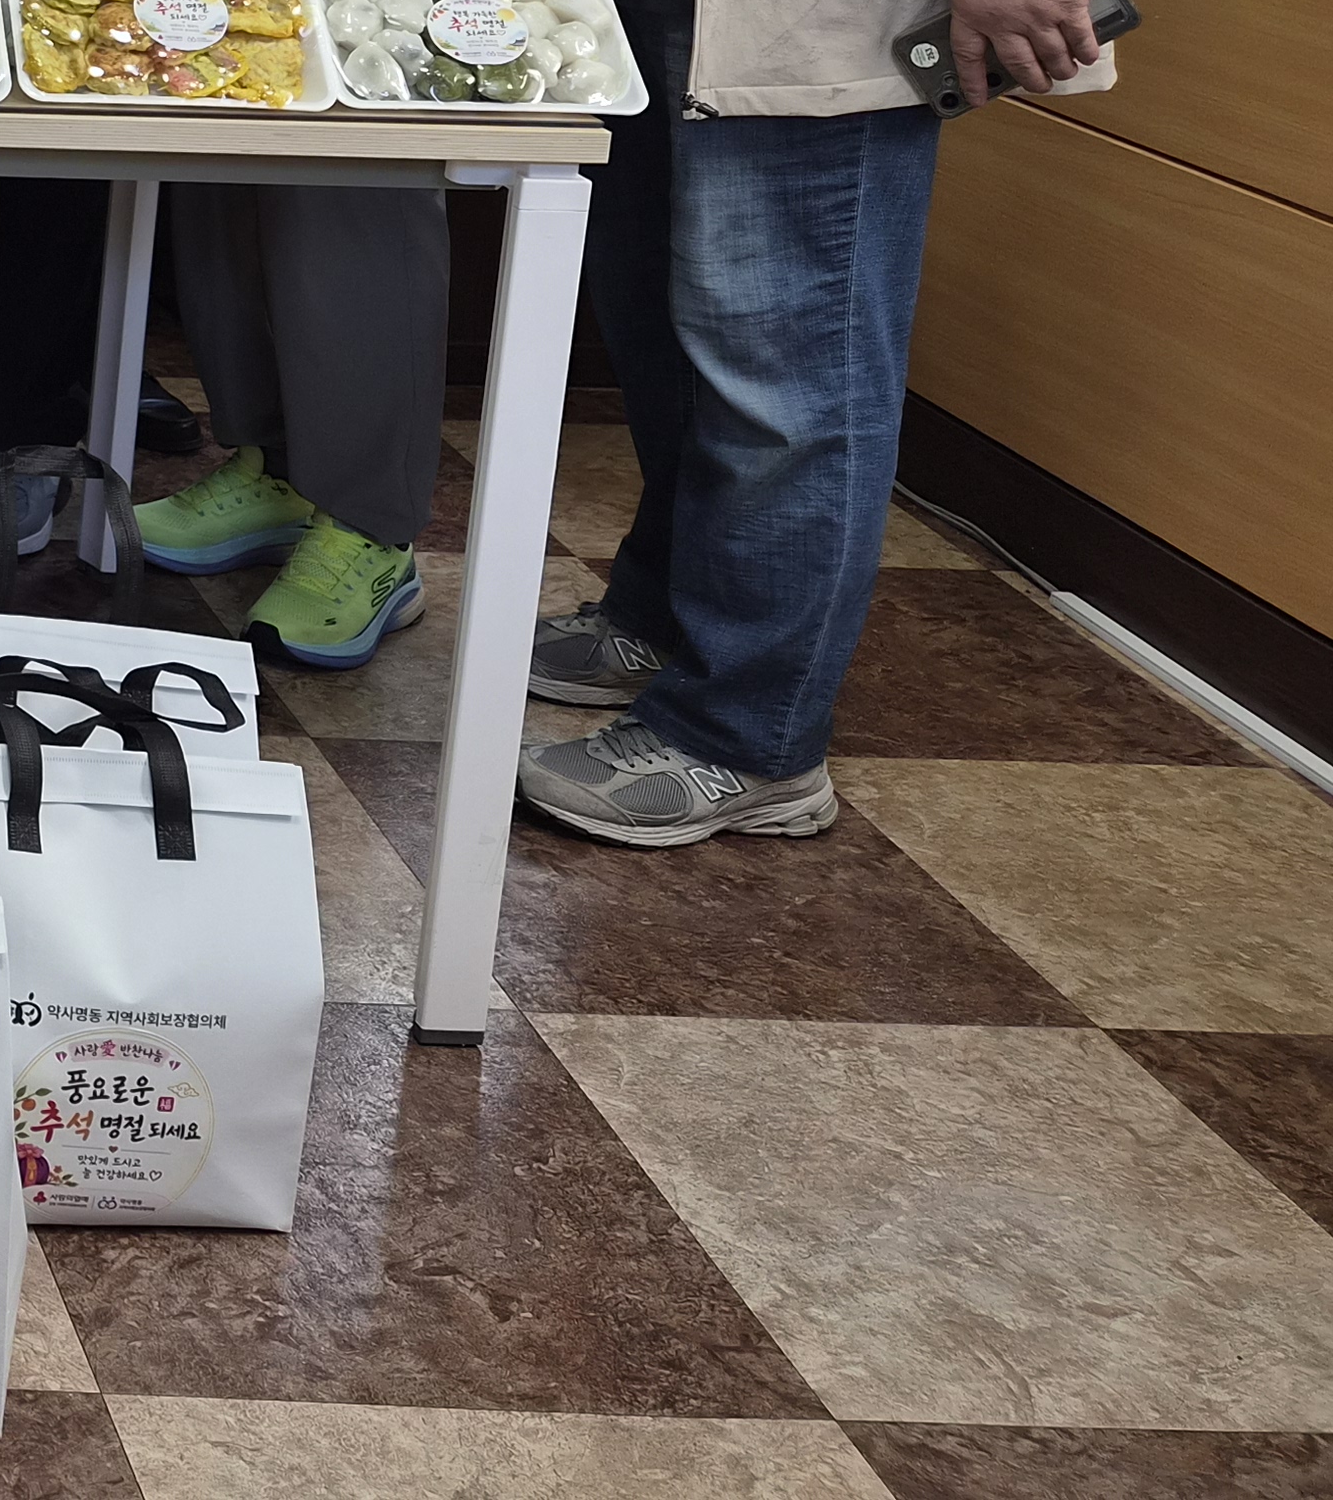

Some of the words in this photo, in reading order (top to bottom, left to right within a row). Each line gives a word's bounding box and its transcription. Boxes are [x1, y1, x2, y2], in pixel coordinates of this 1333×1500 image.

[683, 763, 748, 804] N
[60, 1069, 156, 1107] 풍요로운
[29, 1100, 95, 1143] 추석
[99, 1113, 146, 1143] 명절
[148, 1121, 202, 1141] 되세요
